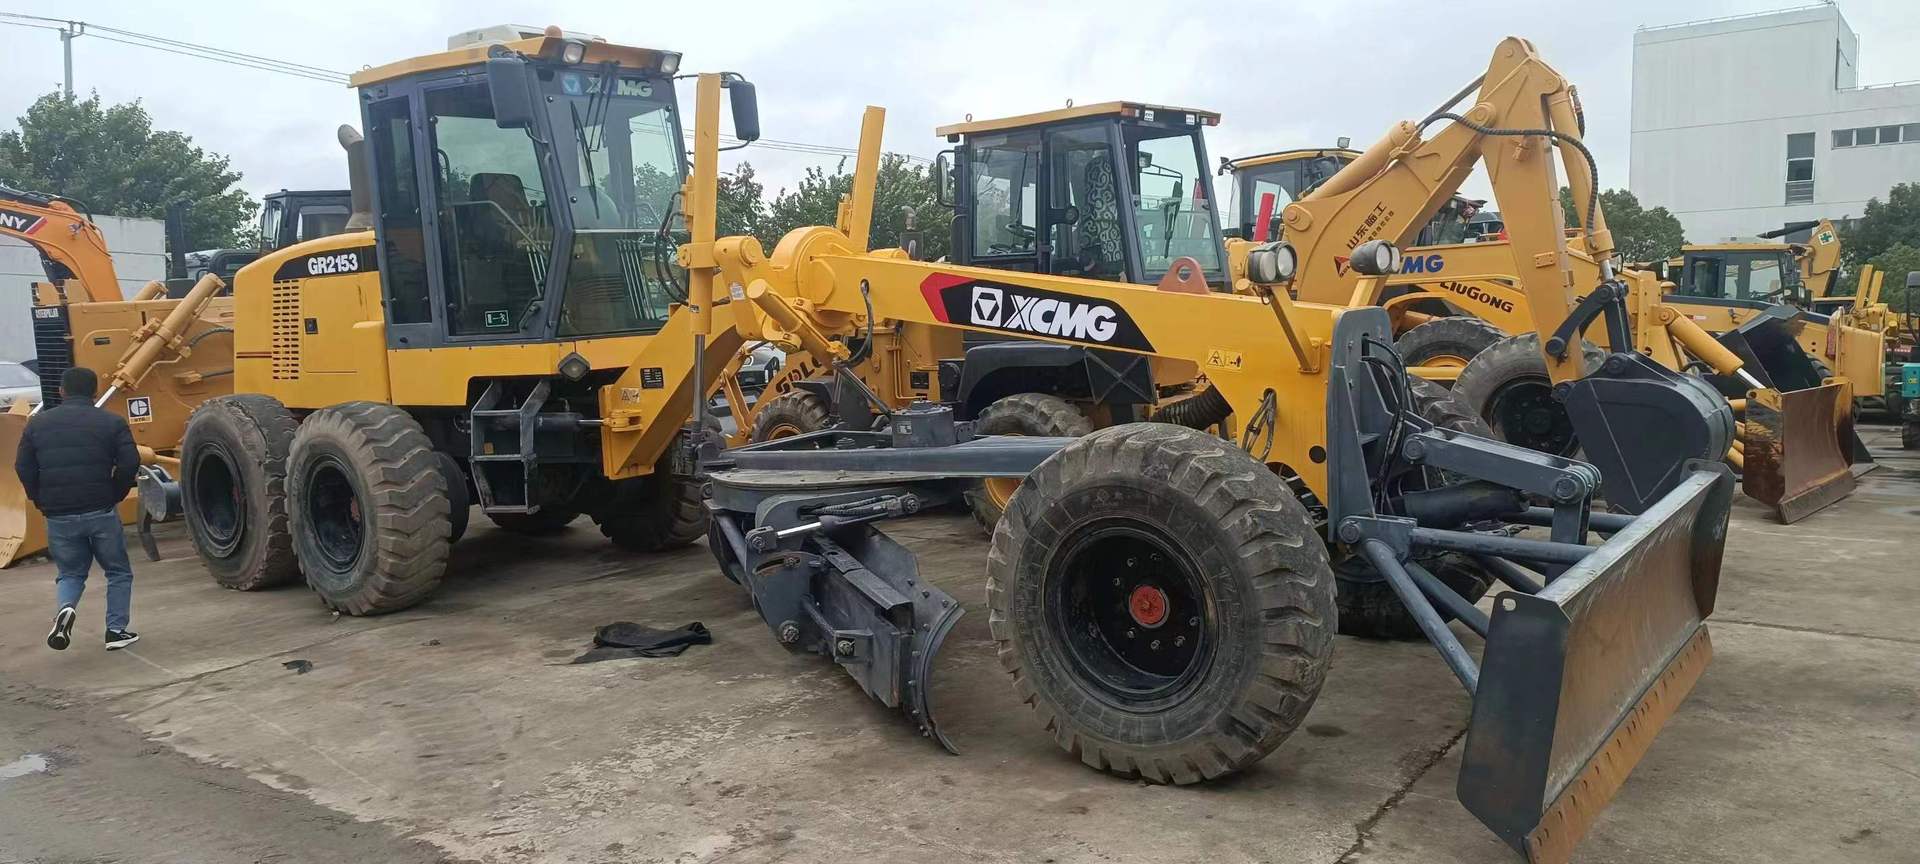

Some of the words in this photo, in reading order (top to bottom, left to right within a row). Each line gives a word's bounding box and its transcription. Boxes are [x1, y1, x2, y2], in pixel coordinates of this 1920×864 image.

[586, 77, 653, 97] XMG
[307, 253, 358, 275] GR2153
[1002, 294, 1118, 342] XCMG
